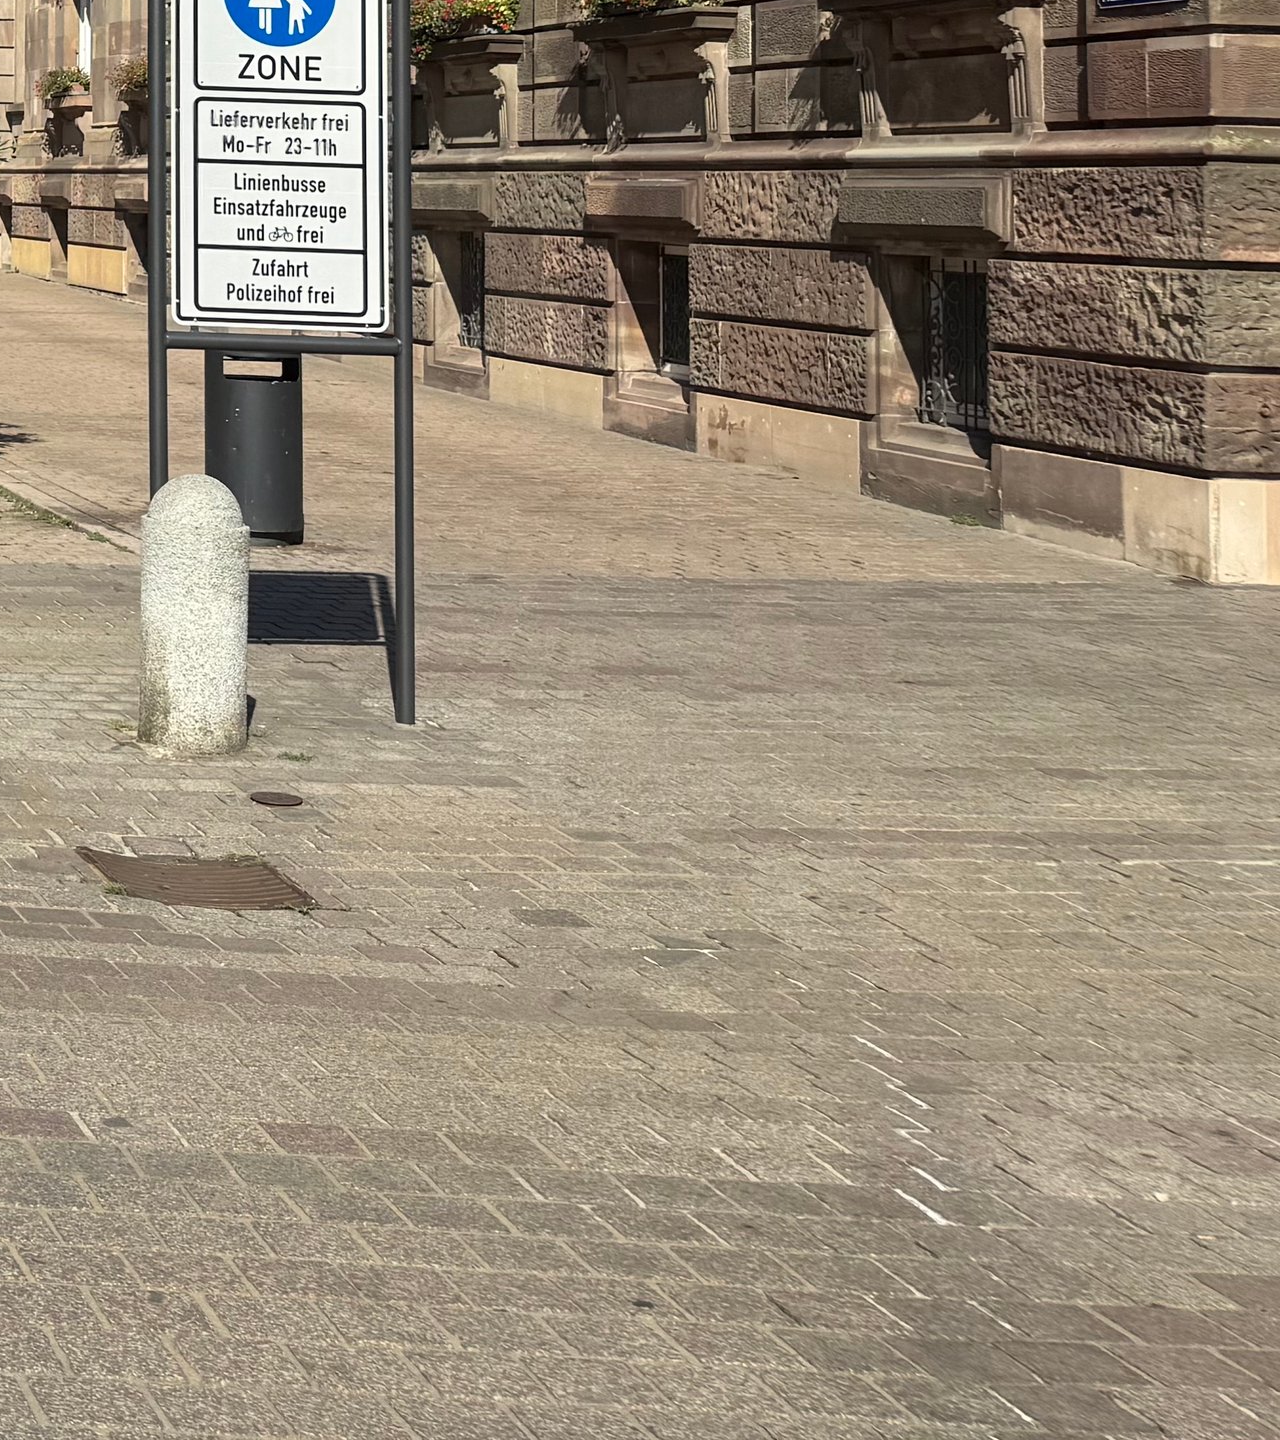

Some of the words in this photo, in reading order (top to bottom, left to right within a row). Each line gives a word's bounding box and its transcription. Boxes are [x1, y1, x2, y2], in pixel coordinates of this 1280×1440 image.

[238, 53, 322, 82] ZONE
[210, 110, 317, 131] Lieferverkehr
[321, 114, 349, 132] frei
[222, 135, 271, 154] Mo-Fr
[284, 137, 337, 157] 23-11h
[234, 172, 326, 194] Linienbusse
[213, 196, 347, 223] Einsatzfahrzeuge
[236, 224, 265, 242] und
[297, 225, 324, 245] frei
[252, 259, 309, 278] Zufahrt
[226, 282, 303, 303] Polizeihof
[307, 286, 335, 305] frei
